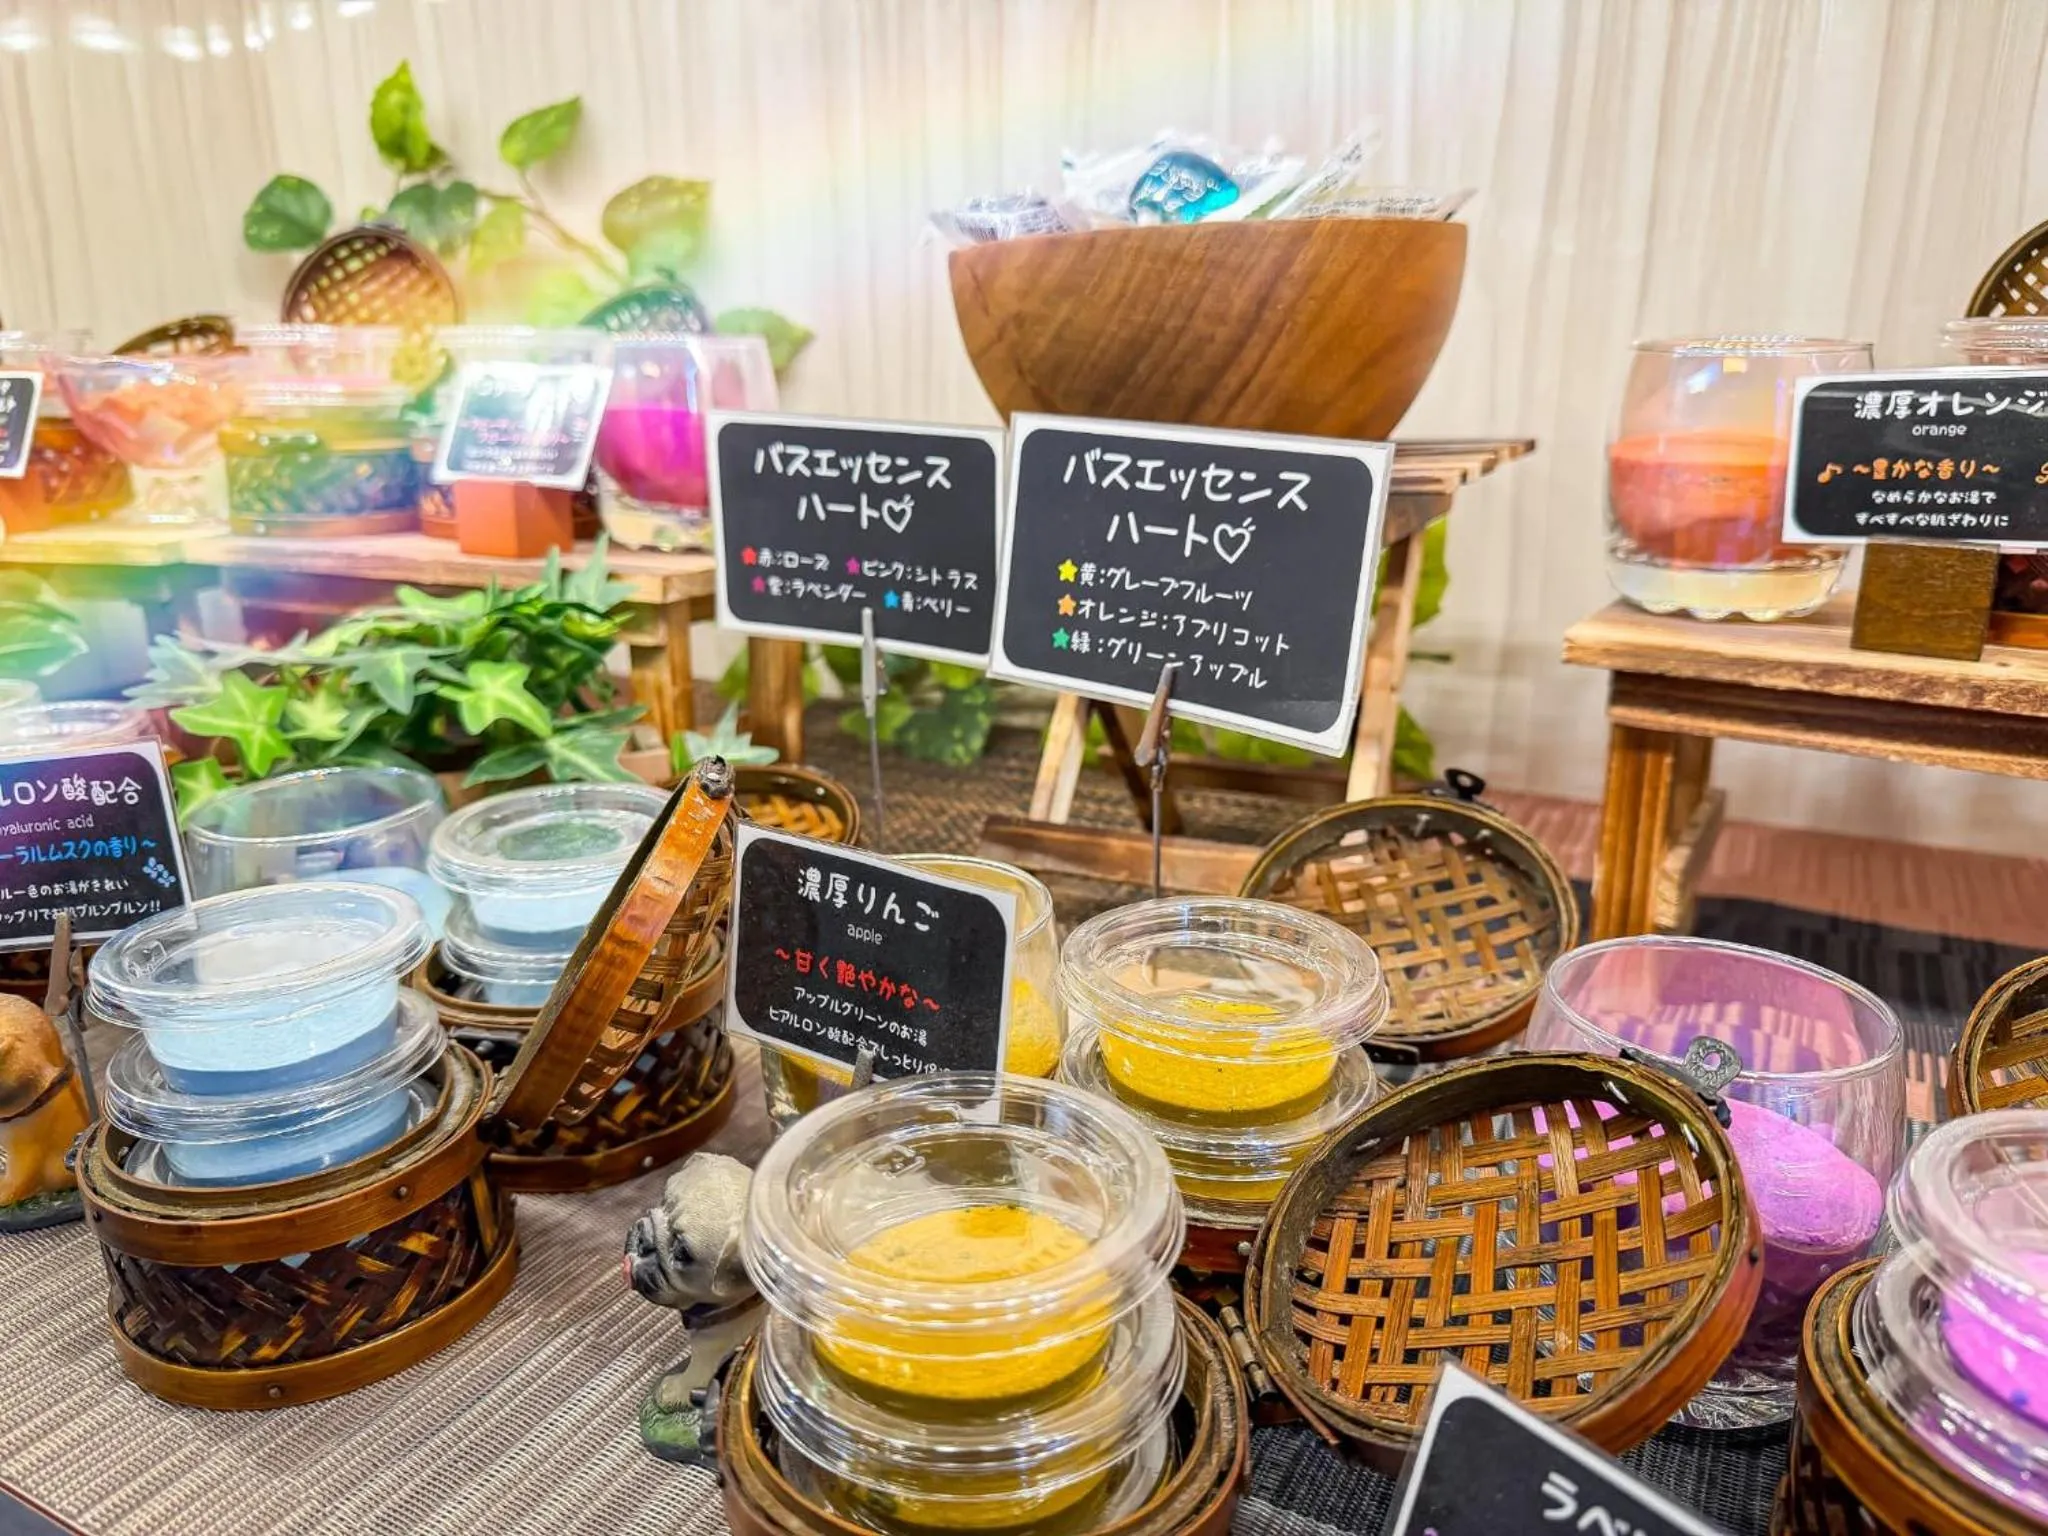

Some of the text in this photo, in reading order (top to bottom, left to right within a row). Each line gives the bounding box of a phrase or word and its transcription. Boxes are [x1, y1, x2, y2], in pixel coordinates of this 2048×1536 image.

[1854, 389, 2048, 420] 濃厚オレンジ
[1911, 423, 1968, 437] orange
[754, 441, 952, 490] バスエッセンス
[1063, 447, 1311, 511] バスエッセンス
[797, 493, 880, 530] ハート
[1872, 490, 1998, 505] なめらかなお湯で
[1106, 511, 1209, 558] ハート
[1854, 512, 2009, 528] すべすべな肌ざわりに
[67, 814, 94, 830] acid
[797, 866, 940, 932] 濃厚りんご
[847, 923, 883, 945] apple
[794, 986, 927, 1047] アップルグリーンのお湯
[1541, 1471, 1648, 1536] ラベ
